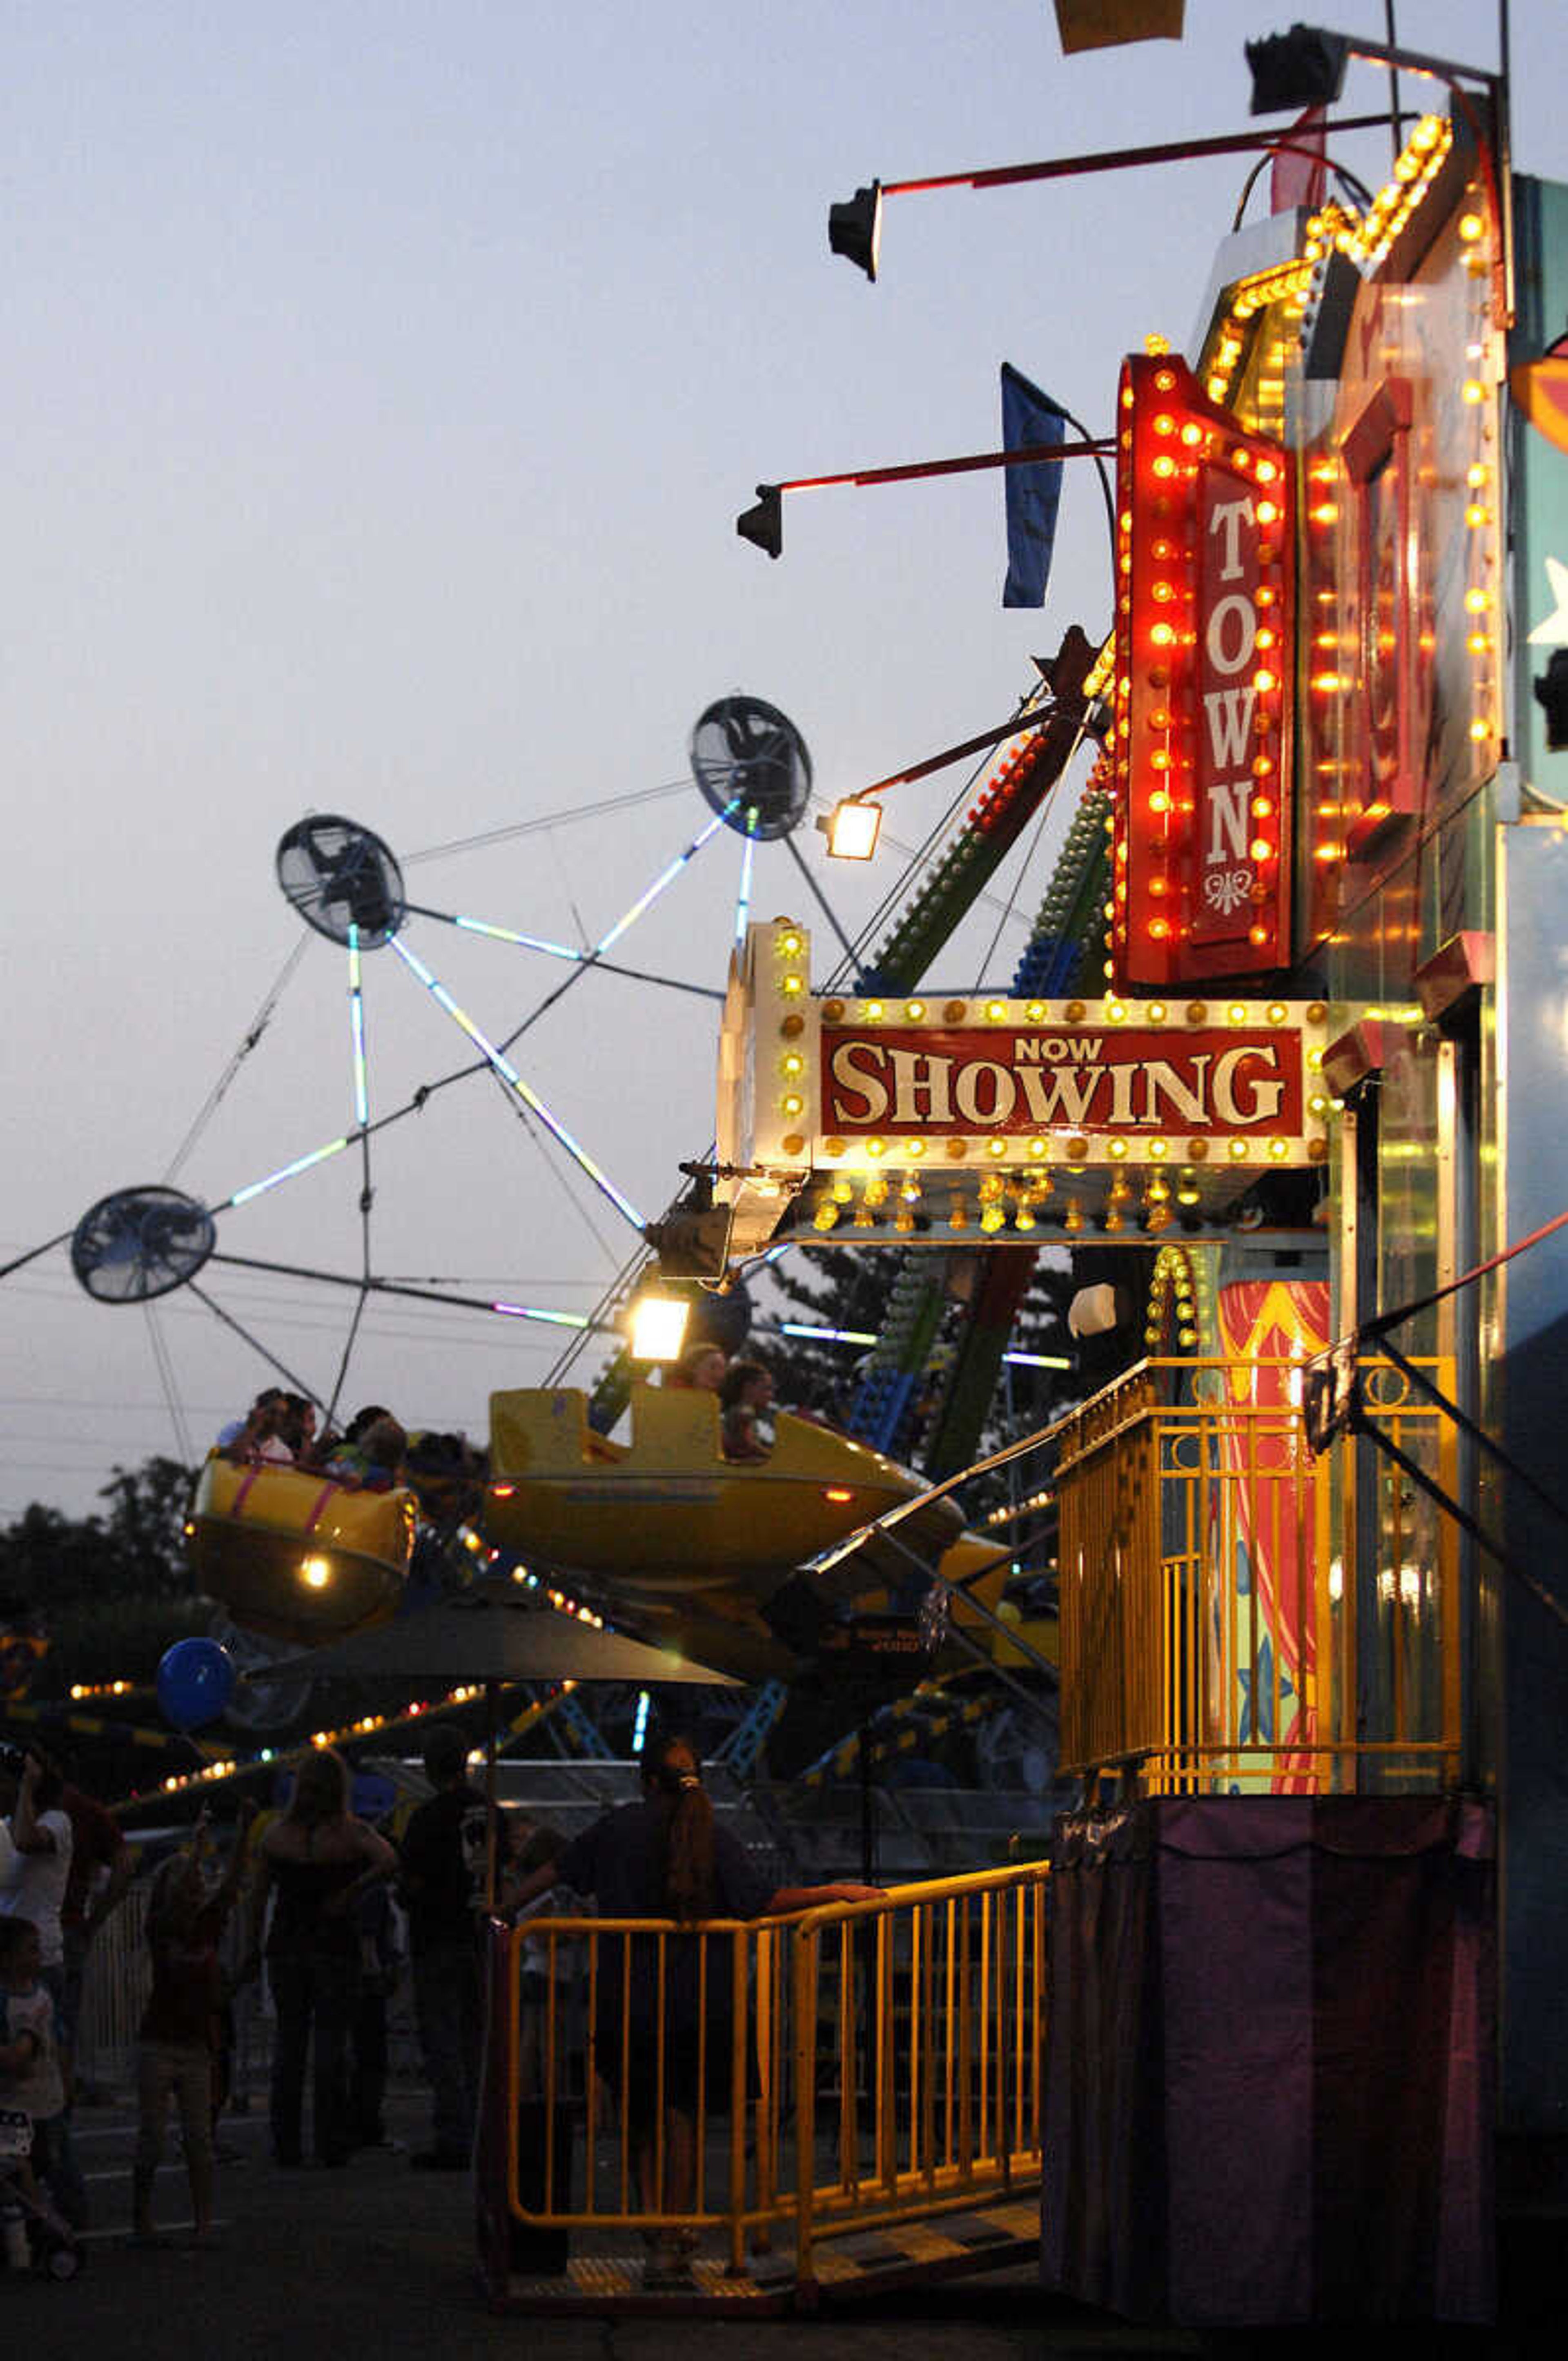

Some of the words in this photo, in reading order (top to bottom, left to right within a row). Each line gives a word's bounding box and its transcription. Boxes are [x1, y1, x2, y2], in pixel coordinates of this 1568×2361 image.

[1204, 497, 1256, 864] TOWN
[832, 1041, 1284, 1125] SHOWING
[1015, 1038, 1103, 1060] NOW
